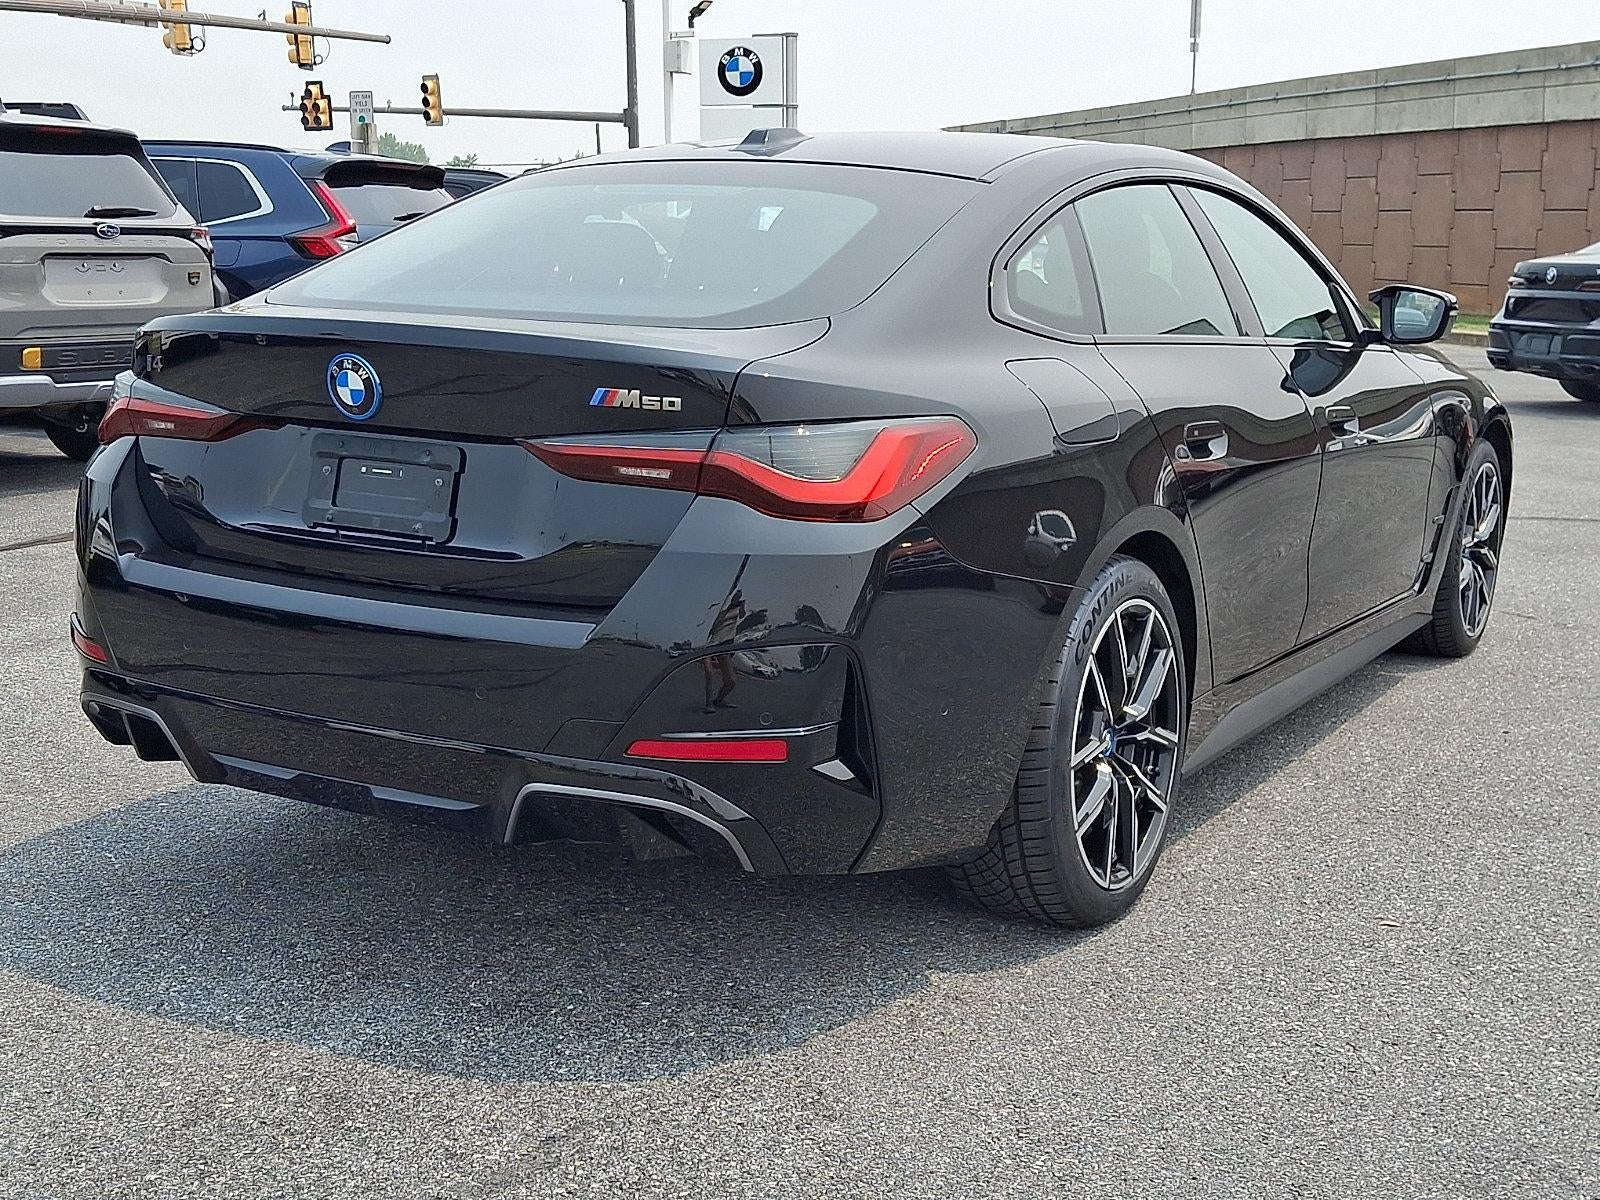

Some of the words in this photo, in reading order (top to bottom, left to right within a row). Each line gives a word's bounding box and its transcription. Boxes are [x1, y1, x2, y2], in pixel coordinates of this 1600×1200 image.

[720, 47, 760, 65] BMW
[37, 237, 169, 246] FORESTER
[331, 359, 370, 380] BMW
[611, 388, 682, 412] M50
